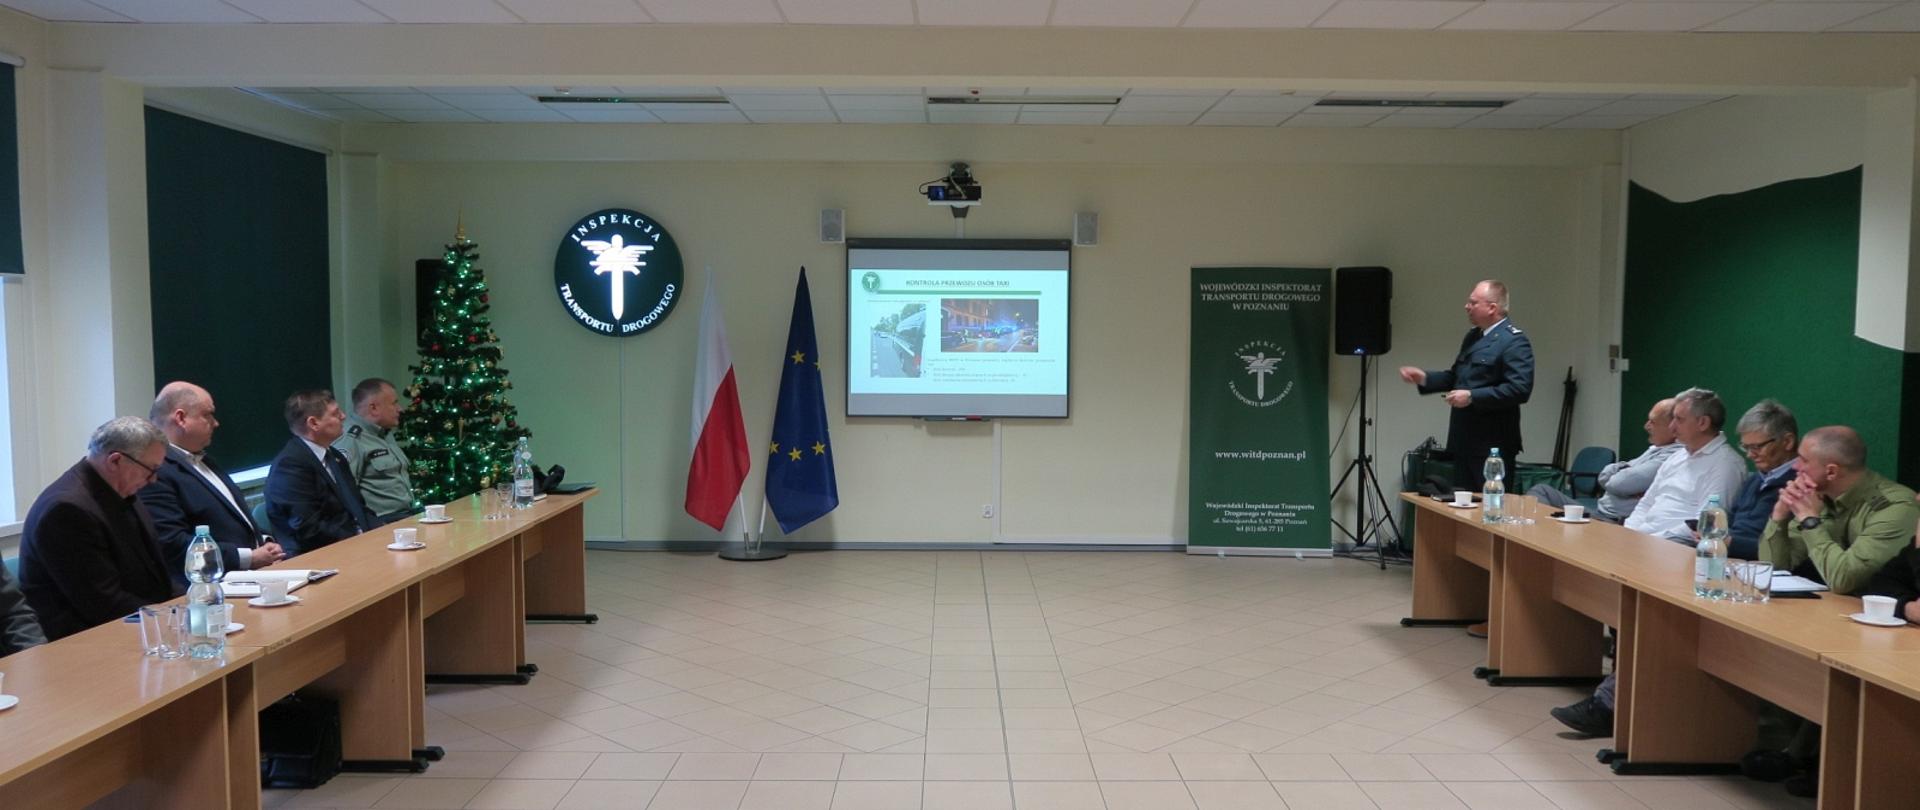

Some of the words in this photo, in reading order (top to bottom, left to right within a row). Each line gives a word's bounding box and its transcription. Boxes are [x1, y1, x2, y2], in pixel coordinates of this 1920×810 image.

[571, 213, 661, 242] INSPEKCJA
[905, 279, 940, 287] KONTROLA
[1200, 282, 1260, 293] WOJEWÓDZKI
[1261, 283, 1322, 292] INSPEKTORAT
[1201, 293, 1260, 301] TRANSPORTU
[1261, 293, 1321, 302] DROGOWEGO
[560, 283, 614, 333] TRANSPORTU
[622, 283, 676, 333] DROGOWEGO
[1232, 303, 1242, 311] W
[1243, 302, 1290, 311] POZNANIU
[1215, 449, 1306, 461] www.witdpoznan.pl
[1205, 502, 1244, 510] Wojewódzki
[1245, 502, 1280, 511] Inspektorat
[1281, 503, 1315, 511] Transportu
[1224, 510, 1260, 518] Drogowego
